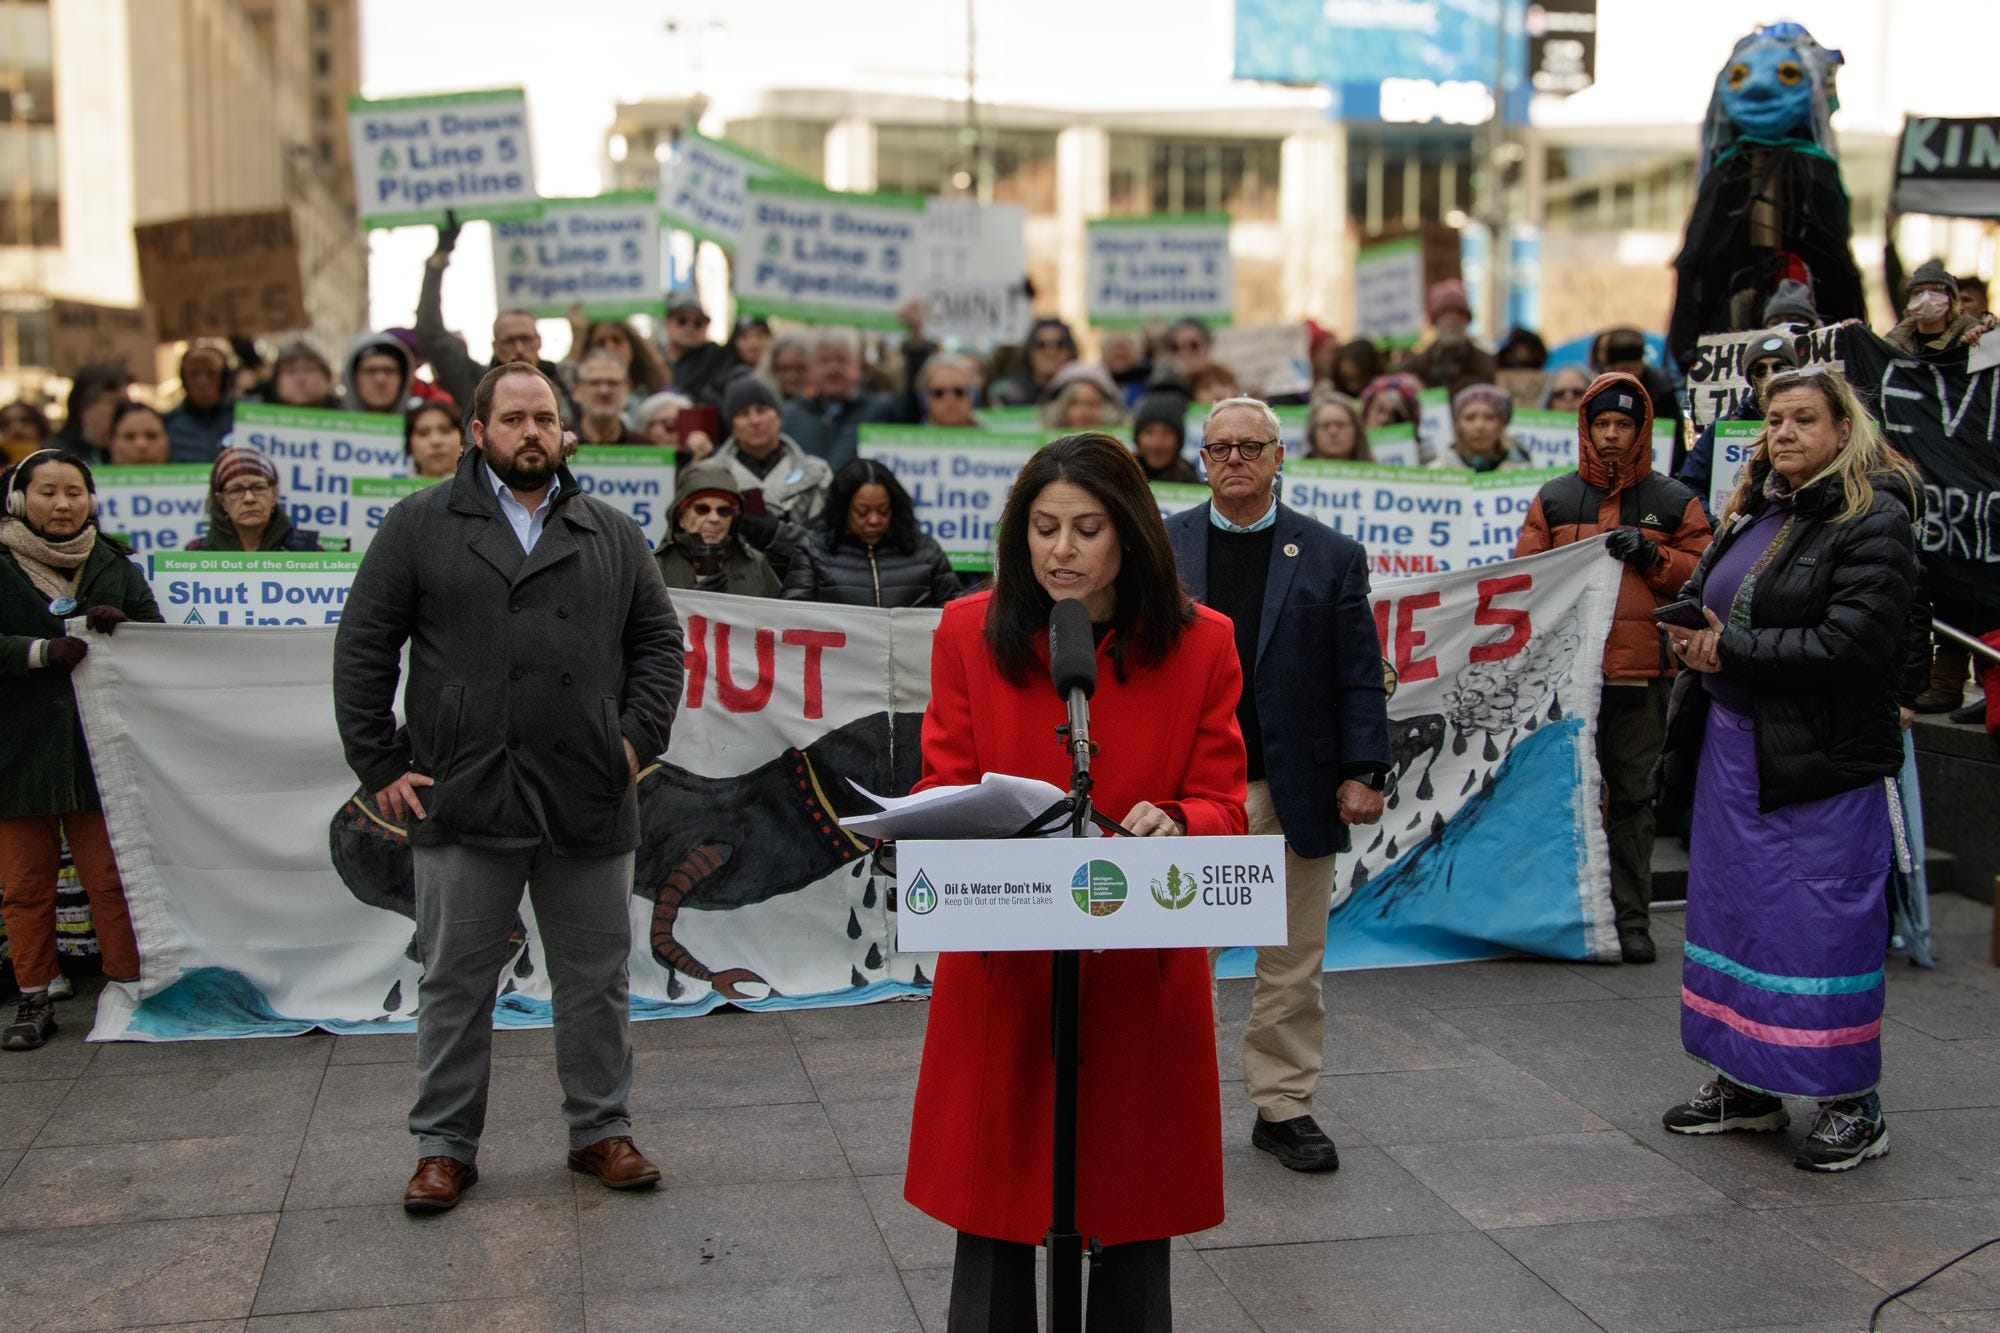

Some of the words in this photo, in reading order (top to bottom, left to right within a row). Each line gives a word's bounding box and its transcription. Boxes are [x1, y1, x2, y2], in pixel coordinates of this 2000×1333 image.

[364, 118, 429, 143] Shut
[439, 112, 522, 135] Down
[408, 144, 484, 170] Line
[497, 136, 519, 163] 5
[377, 172, 523, 205] Pipeline
[567, 214, 645, 237] Down
[757, 204, 822, 229] Shut
[831, 211, 913, 240] Down
[537, 242, 610, 267] Line
[792, 235, 868, 267] Line
[881, 245, 902, 273] 5
[507, 271, 645, 300] Pipeline
[756, 261, 901, 301] Pipeline
[1725, 428, 1747, 437] Keep
[248, 433, 321, 460] Shut
[576, 474, 660, 496] Down
[913, 483, 990, 510] Line
[1292, 484, 1361, 510] Shut
[1375, 489, 1462, 516] Down
[633, 501, 652, 527] 5
[118, 524, 178, 549] ne
[1333, 515, 1414, 545] Line
[1430, 520, 1451, 547] 5
[1469, 522, 1523, 547] in
[165, 560, 197, 571] Keep
[200, 560, 217, 570] Oil
[221, 560, 243, 570] Out
[244, 560, 260, 570] of
[262, 560, 282, 570] the
[286, 560, 319, 570] Great
[322, 560, 358, 570] Lakes
[168, 581, 249, 605] Shut
[1469, 574, 1532, 664] 5
[1202, 864, 1274, 885] SIERRA
[944, 883, 958, 895] Oil
[961, 884, 969, 895] &
[971, 883, 1001, 895] Water
[1004, 882, 1030, 894] Don't
[1033, 882, 1052, 894] Mix
[944, 897, 962, 907] Keep
[964, 897, 974, 906] Oil
[975, 897, 988, 906] Out
[989, 897, 997, 905] of
[998, 896, 1010, 905] the
[1011, 896, 1031, 905] Great
[1032, 896, 1053, 905] Lakes
[1202, 886, 1252, 906] CLUB
